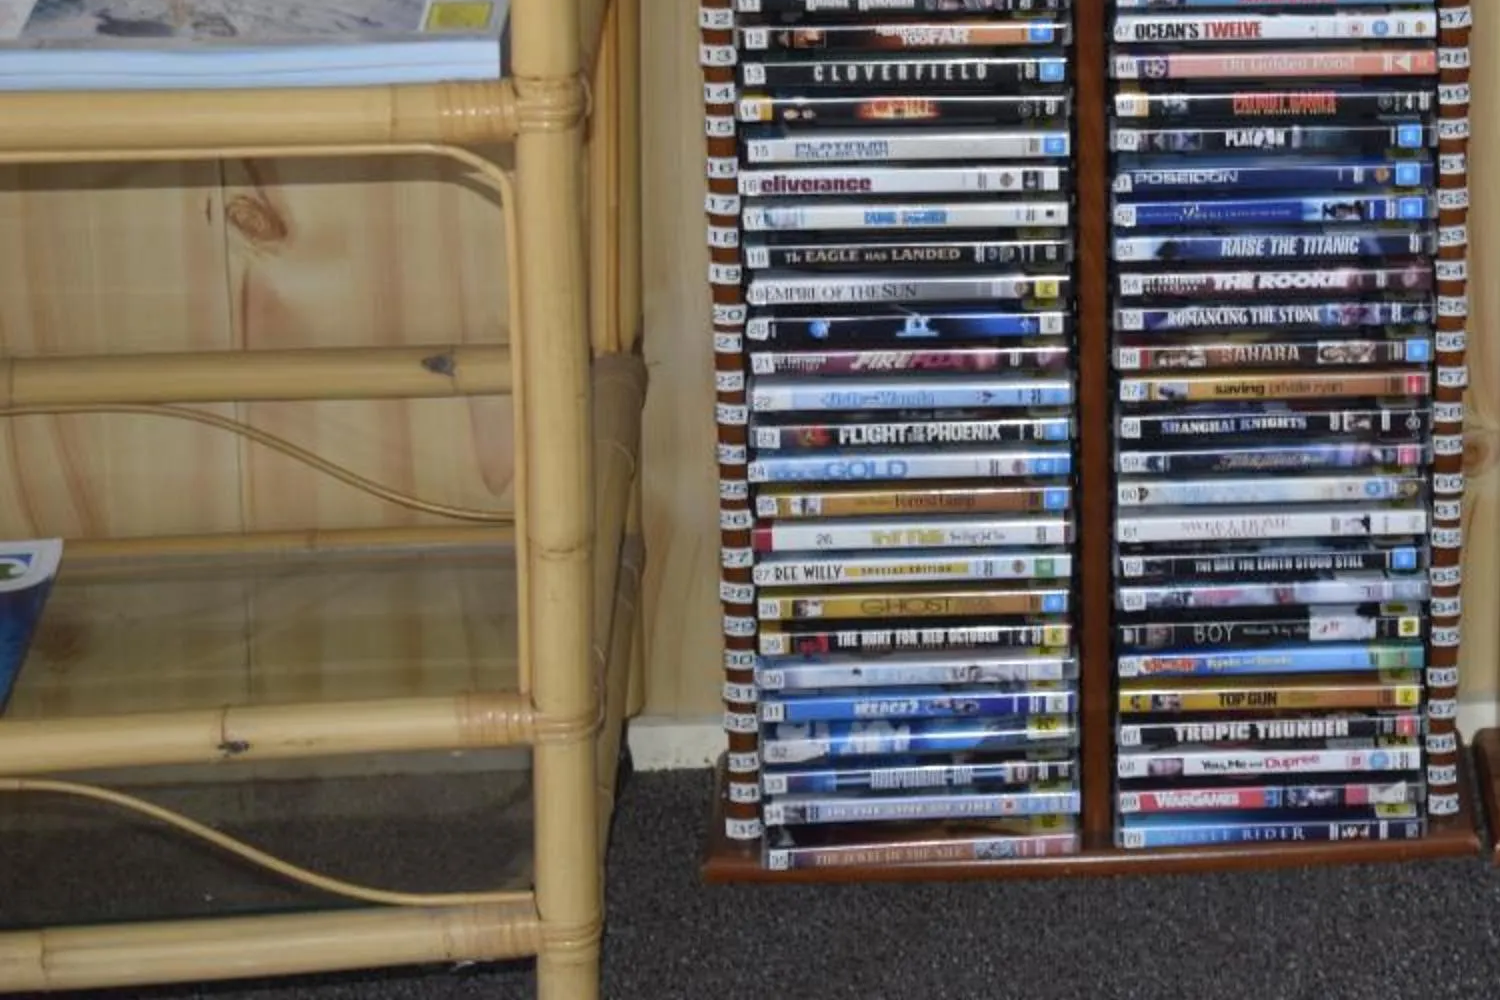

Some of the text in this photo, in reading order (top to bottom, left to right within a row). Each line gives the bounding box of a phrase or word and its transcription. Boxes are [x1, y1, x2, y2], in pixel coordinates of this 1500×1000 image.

[1134, 21, 1262, 39] OCEAN'S TWELVE
[813, 63, 987, 82] CLOVERFIELD
[761, 176, 872, 193] eliverance
[1134, 170, 1239, 184] POSEIDON
[806, 249, 859, 262] EAGLE
[891, 248, 961, 261] LANDED
[1220, 235, 1360, 257] RAISE THE TITANIC
[765, 282, 918, 300] EMPIRE OF THE SUN
[1212, 273, 1256, 291] THE
[1167, 307, 1248, 325] ROMANCING
[1251, 307, 1276, 324] THE
[1221, 345, 1299, 363] SAHARA
[1215, 382, 1265, 397] saving
[839, 423, 1001, 444] FLIGHT PHOENIX
[1161, 417, 1307, 433] SHANGHAI KNIGHTS
[824, 459, 908, 477] GOLD
[804, 564, 843, 580] WILLY
[860, 599, 952, 613] GHOST
[837, 631, 858, 646] THE
[949, 630, 999, 643] OCTOBER
[1193, 624, 1234, 643] BOY
[1217, 691, 1278, 707] TOP GUN
[1174, 720, 1349, 742] TROPIC THUNDER
[1242, 826, 1306, 841] RIDER
